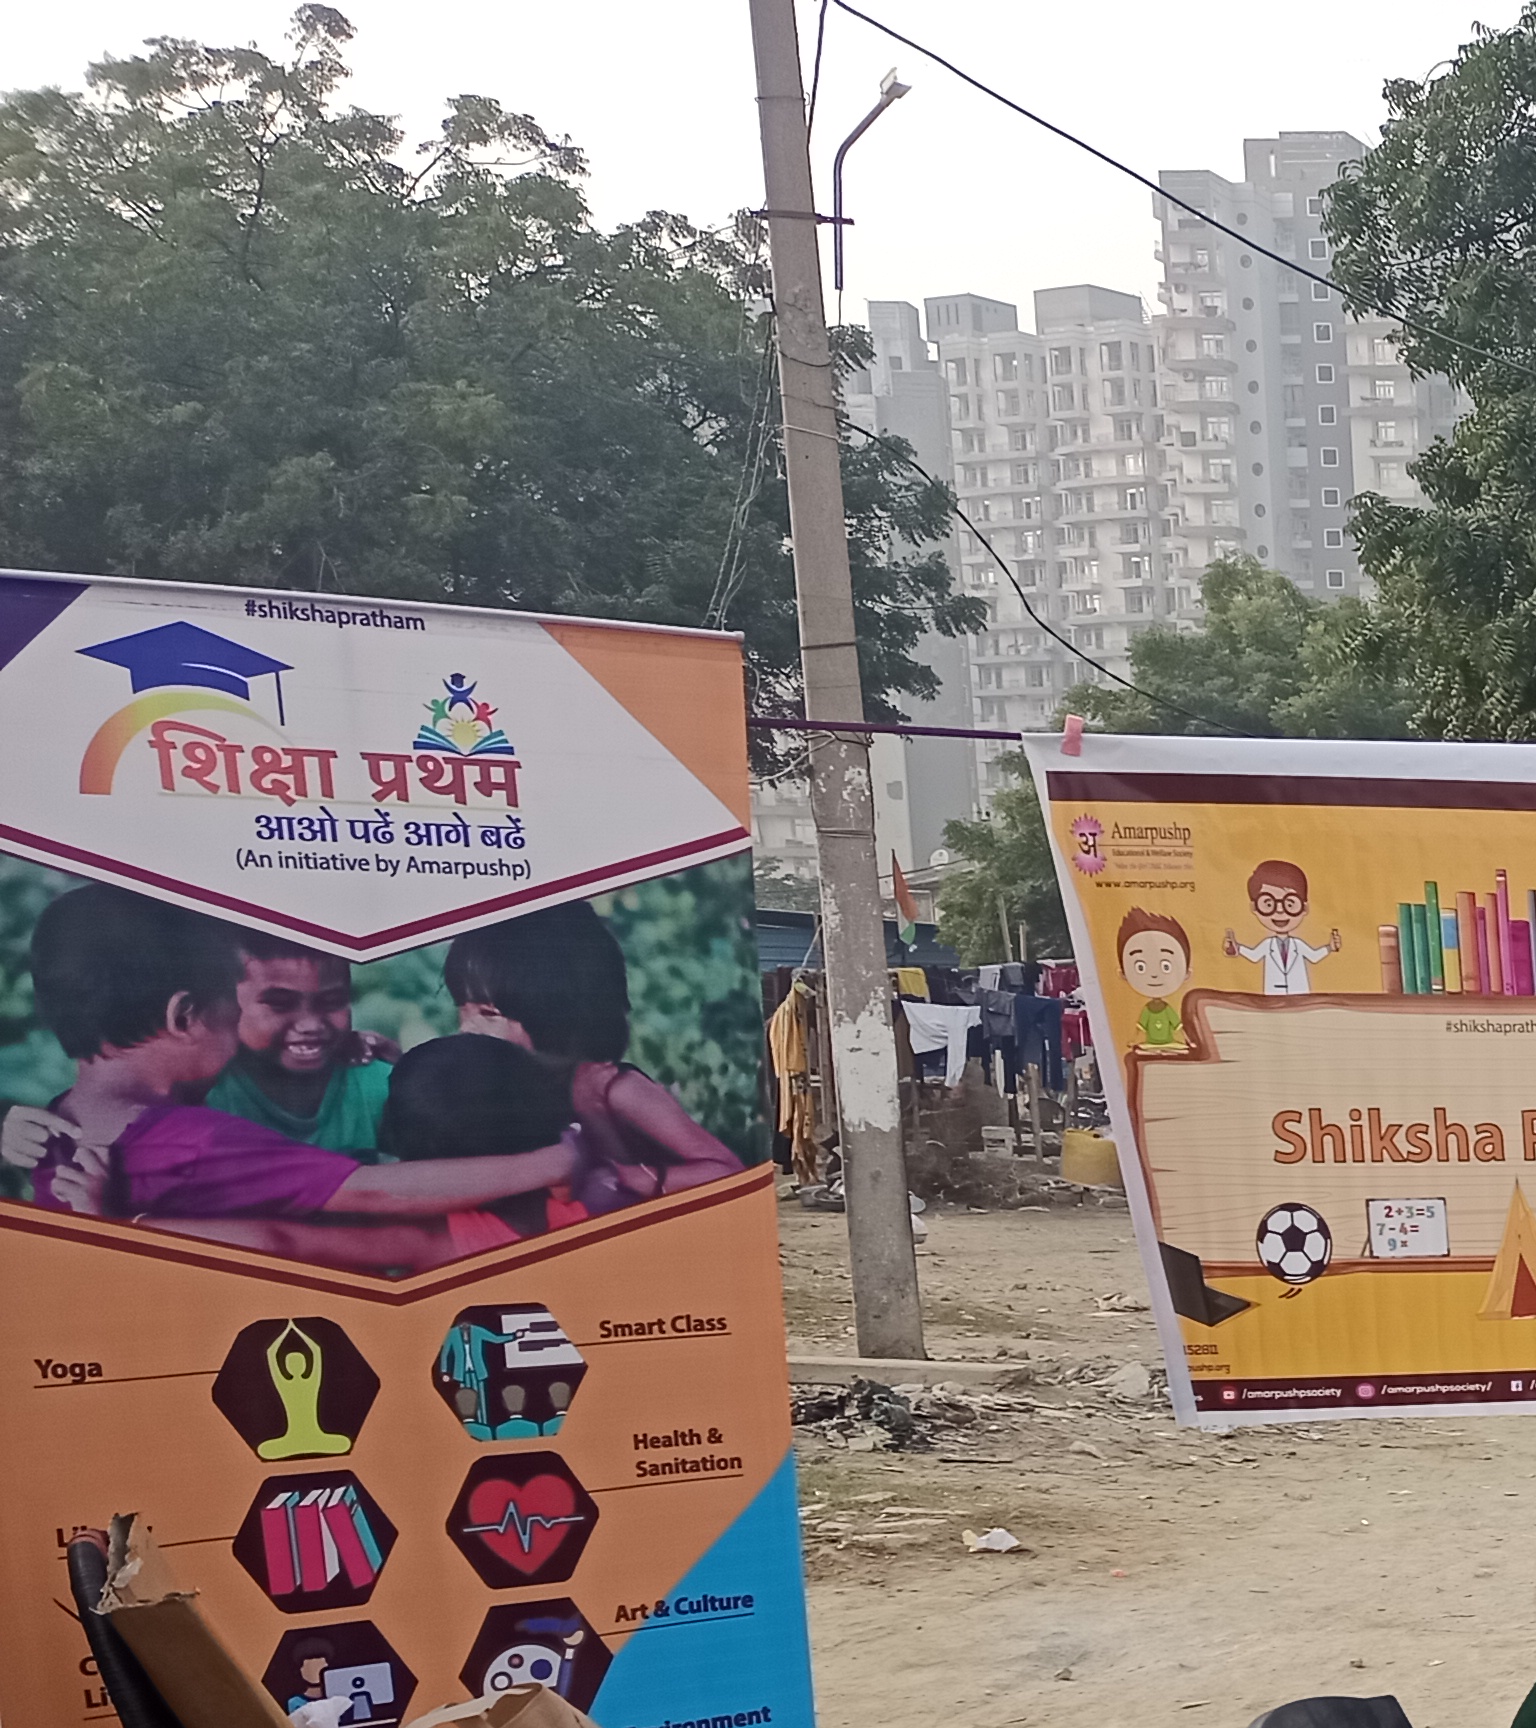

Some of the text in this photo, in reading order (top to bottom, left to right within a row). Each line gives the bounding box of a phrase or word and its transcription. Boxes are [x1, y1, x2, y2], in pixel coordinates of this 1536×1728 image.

[245, 600, 426, 631] #shikshapratham
[147, 720, 522, 808] शिक्षा प्रथम
[255, 806, 338, 844] आओ
[404, 812, 471, 848] आगे
[1111, 821, 1191, 845] Amarpushp
[1078, 832, 1098, 858] अ
[236, 848, 531, 880] (An initiative by Amarpushp)
[1095, 879, 1196, 892] www.amarpushp.org
[1272, 1107, 1505, 1164] Shiksha
[599, 1314, 727, 1338] Smart Class
[34, 1357, 104, 1384] Yoga
[1241, 1386, 1342, 1400] /amarpushpsociety
[1381, 1382, 1492, 1395] /amarpushpsociety/
[633, 1427, 723, 1450] Health &
[635, 1455, 743, 1477] Sanitation
[615, 1591, 754, 1624] Art & Culture
